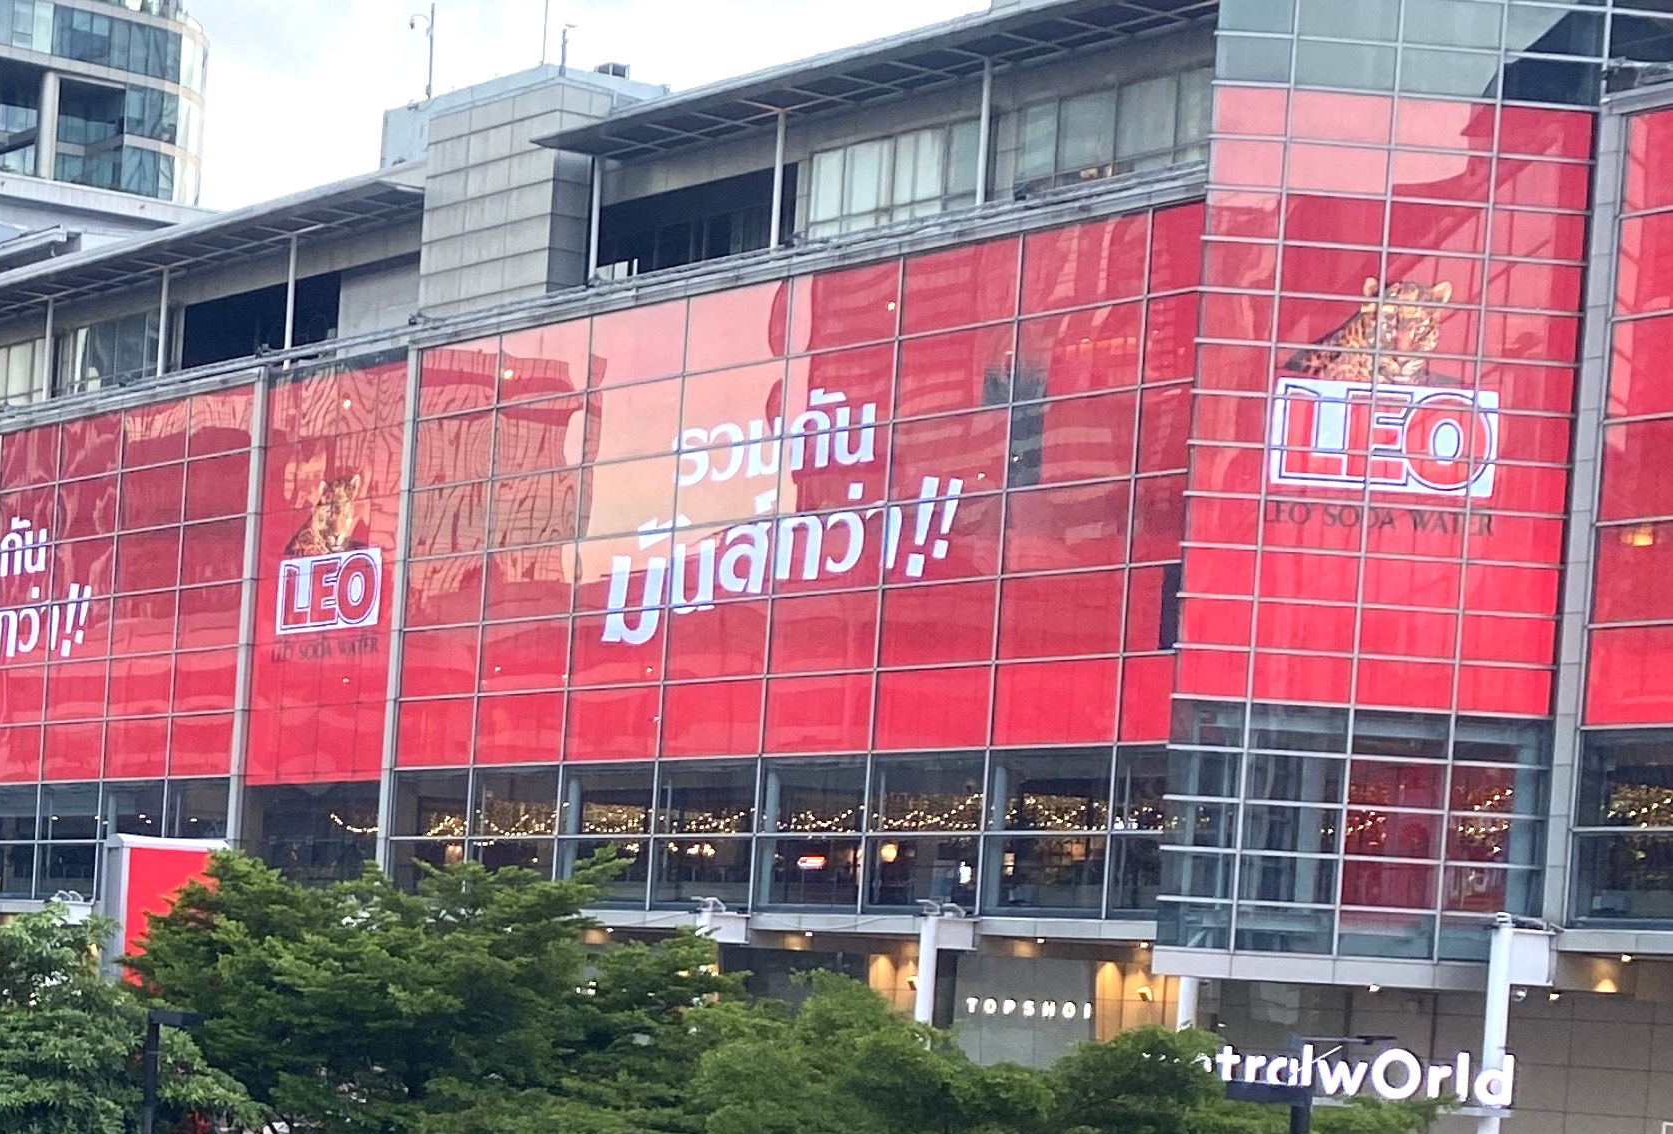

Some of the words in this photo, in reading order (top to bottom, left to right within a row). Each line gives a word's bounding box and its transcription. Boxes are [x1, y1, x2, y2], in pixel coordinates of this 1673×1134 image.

[671, 388, 876, 487] รวมกัน
[1278, 383, 1493, 491] LEO
[280, 552, 379, 631] LEO
